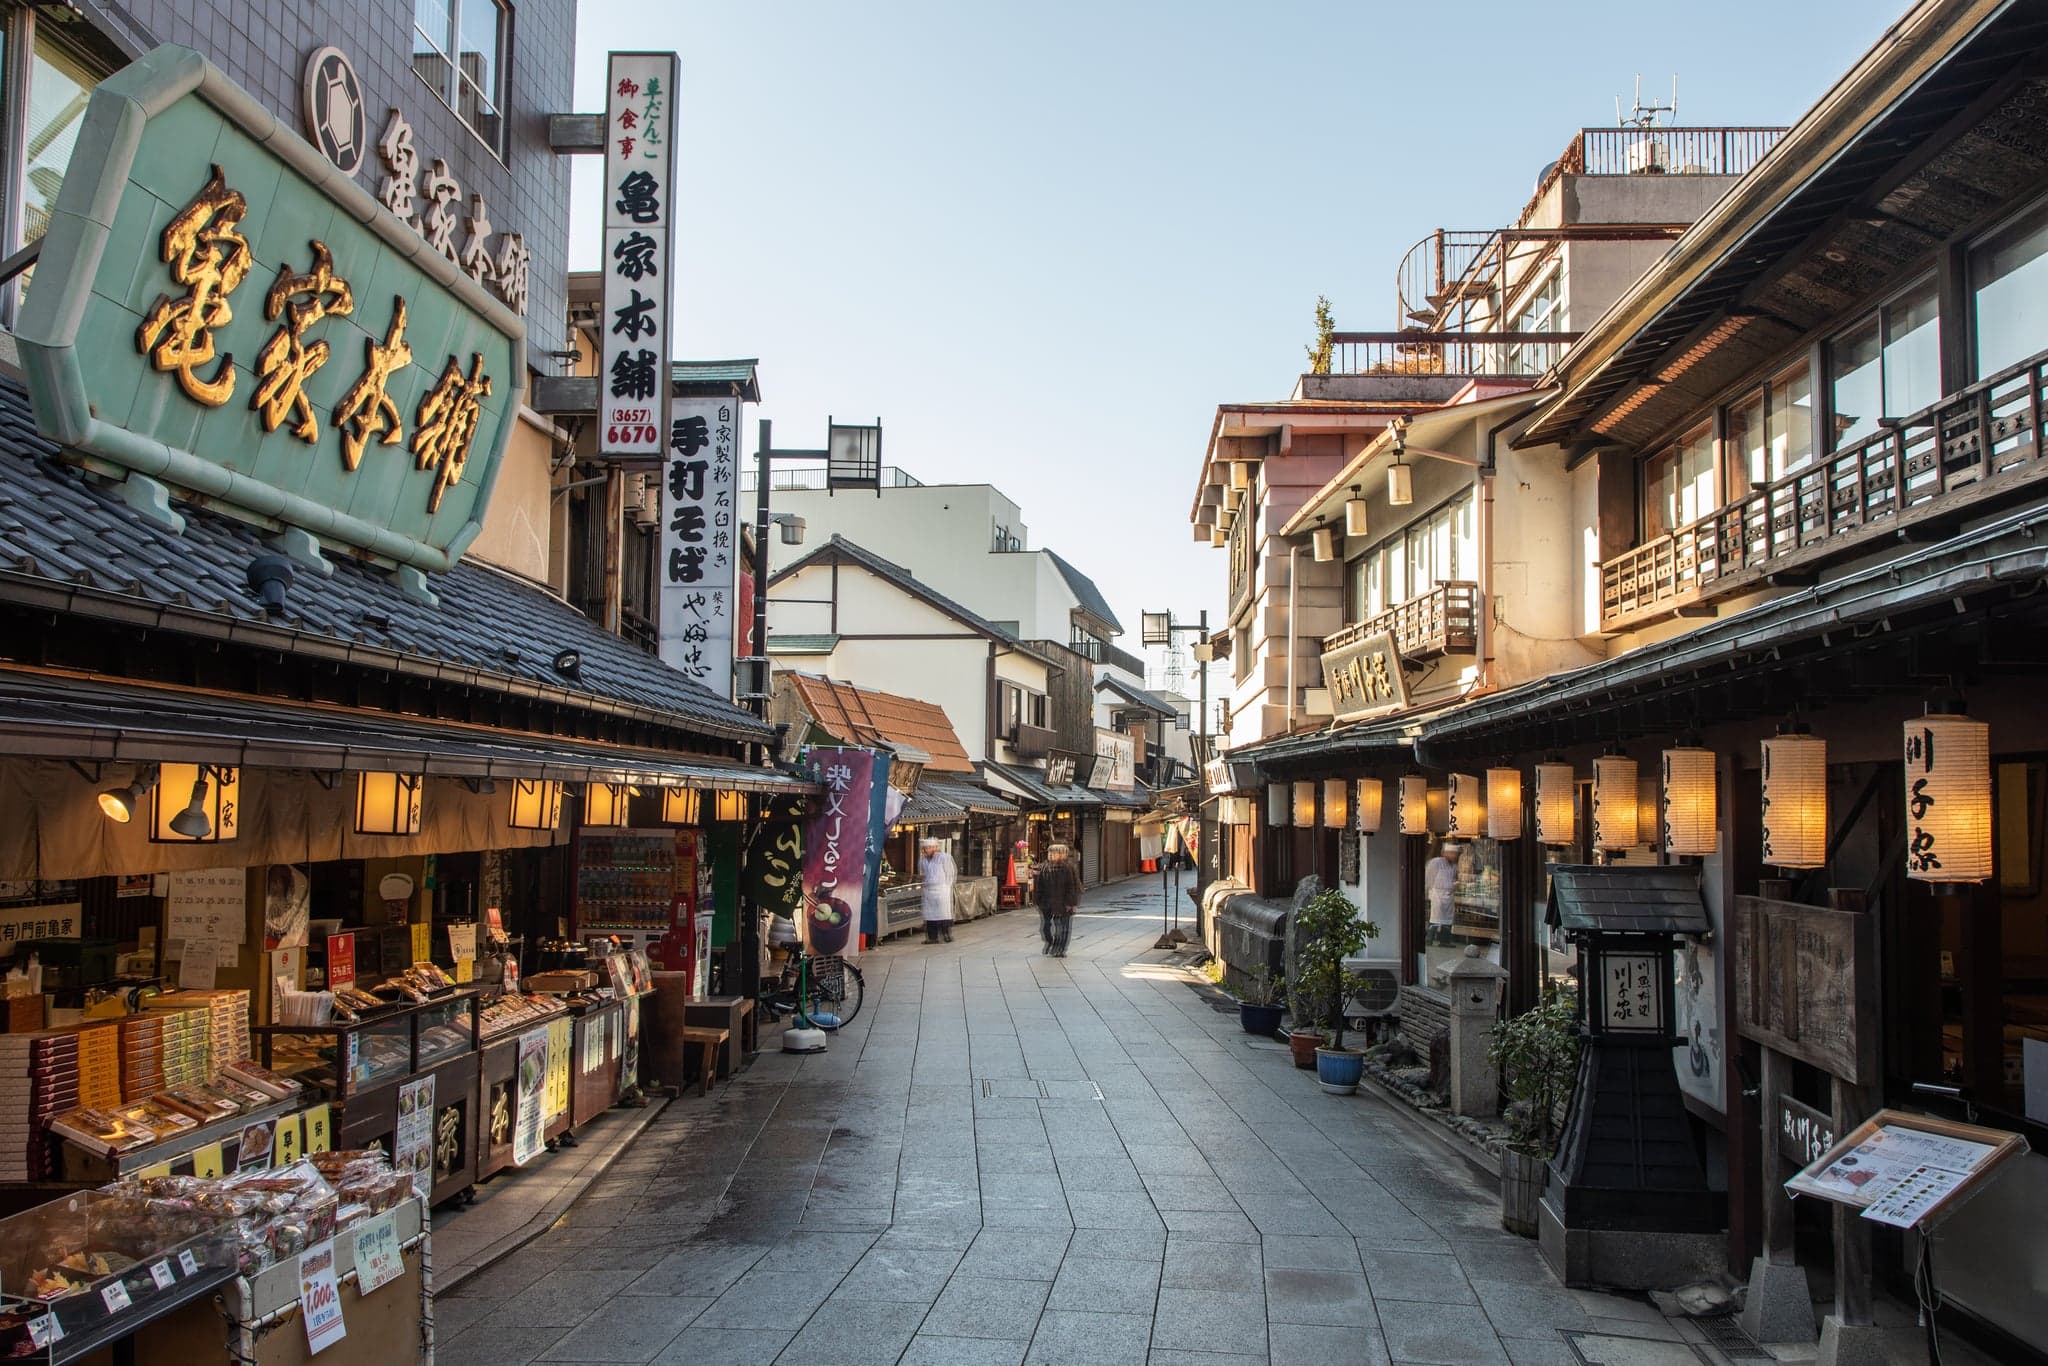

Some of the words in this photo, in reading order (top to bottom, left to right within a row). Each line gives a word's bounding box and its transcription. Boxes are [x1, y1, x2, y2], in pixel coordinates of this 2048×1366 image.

[617, 77, 639, 160] 御食事
[643, 77, 662, 159] 草だんご
[607, 426, 657, 444] 6670
[612, 408, 651, 423] (3657)
[713, 404, 732, 484] 自家製粉
[668, 415, 709, 583] 手打そば
[711, 591, 724, 617] 柴又
